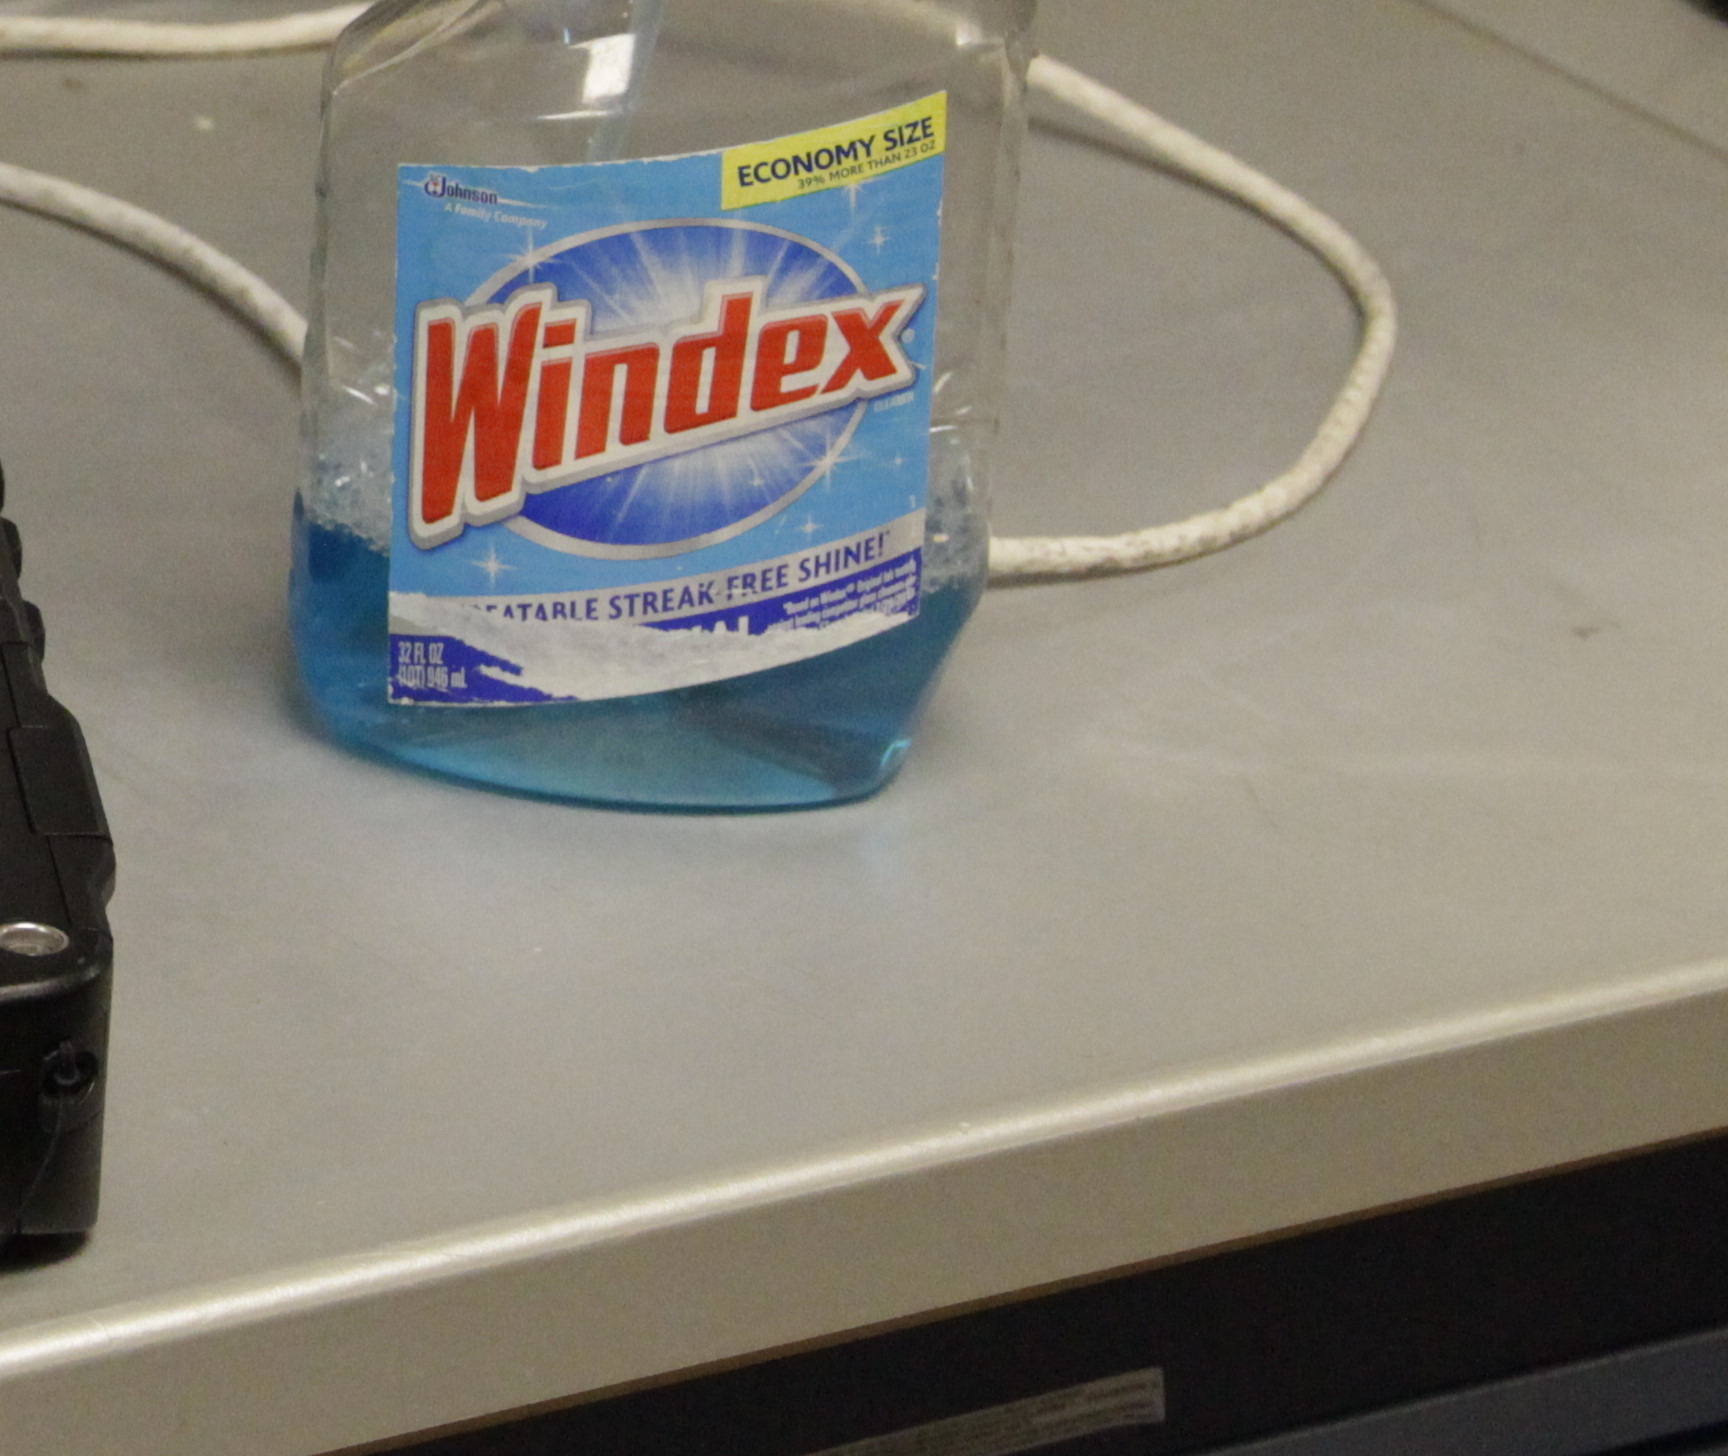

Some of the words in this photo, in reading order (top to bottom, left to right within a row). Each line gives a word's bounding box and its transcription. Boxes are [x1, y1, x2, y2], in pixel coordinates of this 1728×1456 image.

[737, 134, 876, 188] ECONOMY
[883, 116, 935, 152] SIZE
[828, 163, 864, 182] MORE
[867, 153, 902, 172] THAN
[904, 146, 918, 159] 23
[920, 140, 936, 153] OZ
[418, 289, 907, 527] Windex
[398, 640, 412, 664] 32
[429, 642, 444, 664] OZ
[427, 665, 448, 690] 946
